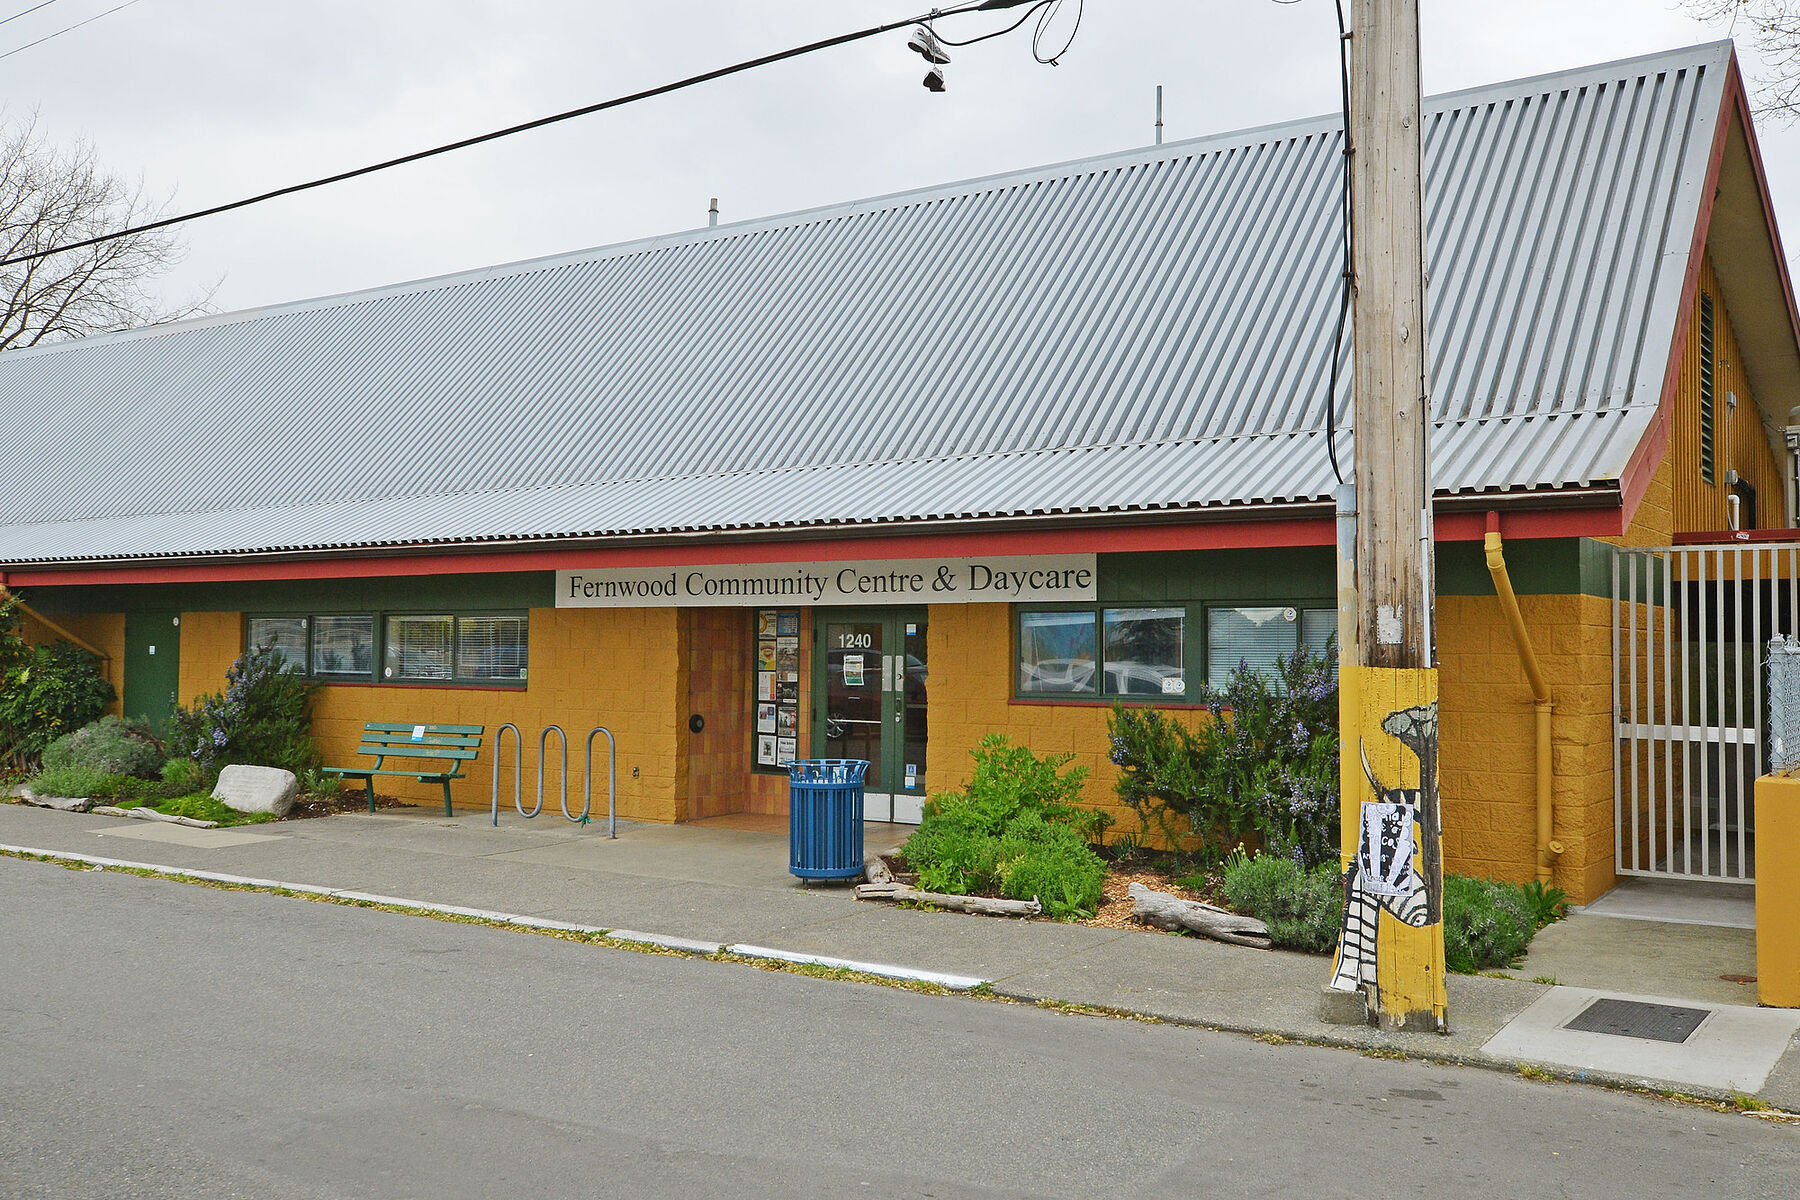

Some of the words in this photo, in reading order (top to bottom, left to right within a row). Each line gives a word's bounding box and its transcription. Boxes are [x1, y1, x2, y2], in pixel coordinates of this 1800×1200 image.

[568, 573, 678, 598] Fernwood
[685, 570, 829, 602] Community
[836, 569, 924, 594] Centre
[931, 565, 958, 592] &
[967, 564, 1092, 597] Daycare
[838, 633, 872, 649] 1240
